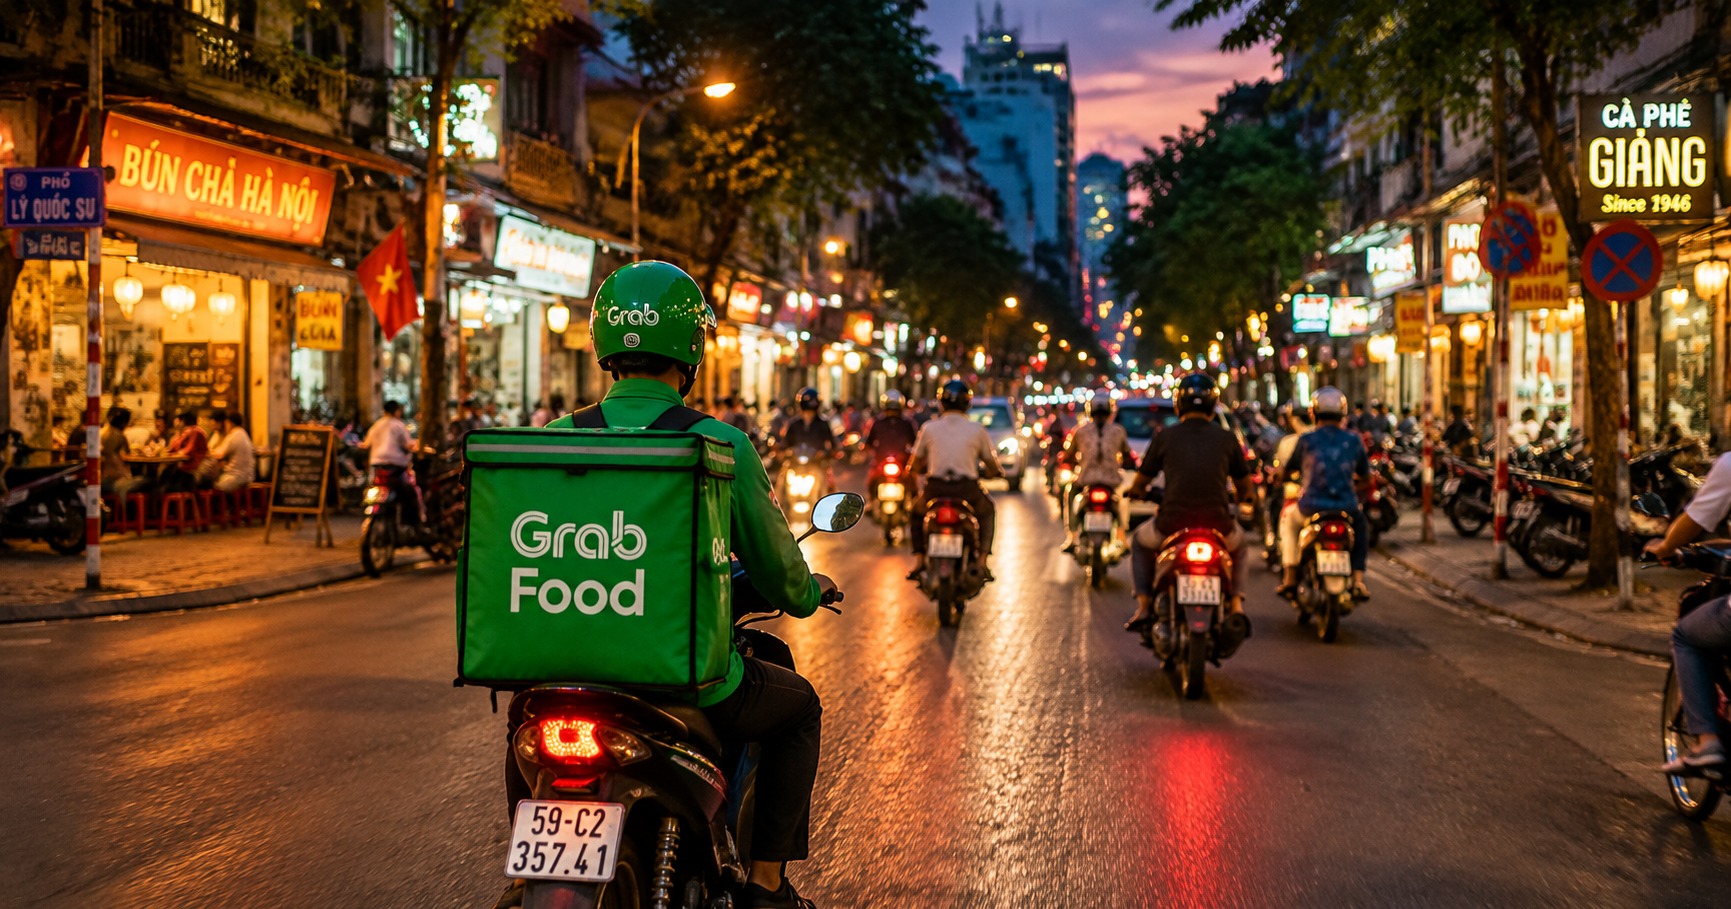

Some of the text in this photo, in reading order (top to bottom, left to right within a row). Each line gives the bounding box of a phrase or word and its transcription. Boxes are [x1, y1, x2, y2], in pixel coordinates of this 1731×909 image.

[119, 139, 319, 231] BÚN CHẢ HÀ NỘI
[1601, 194, 1692, 213] Since 1946
[607, 303, 659, 326] Grab
[510, 510, 648, 561] Grab
[510, 567, 645, 617] Food
[531, 806, 606, 838] 59-C2
[512, 840, 608, 876] 357.41
